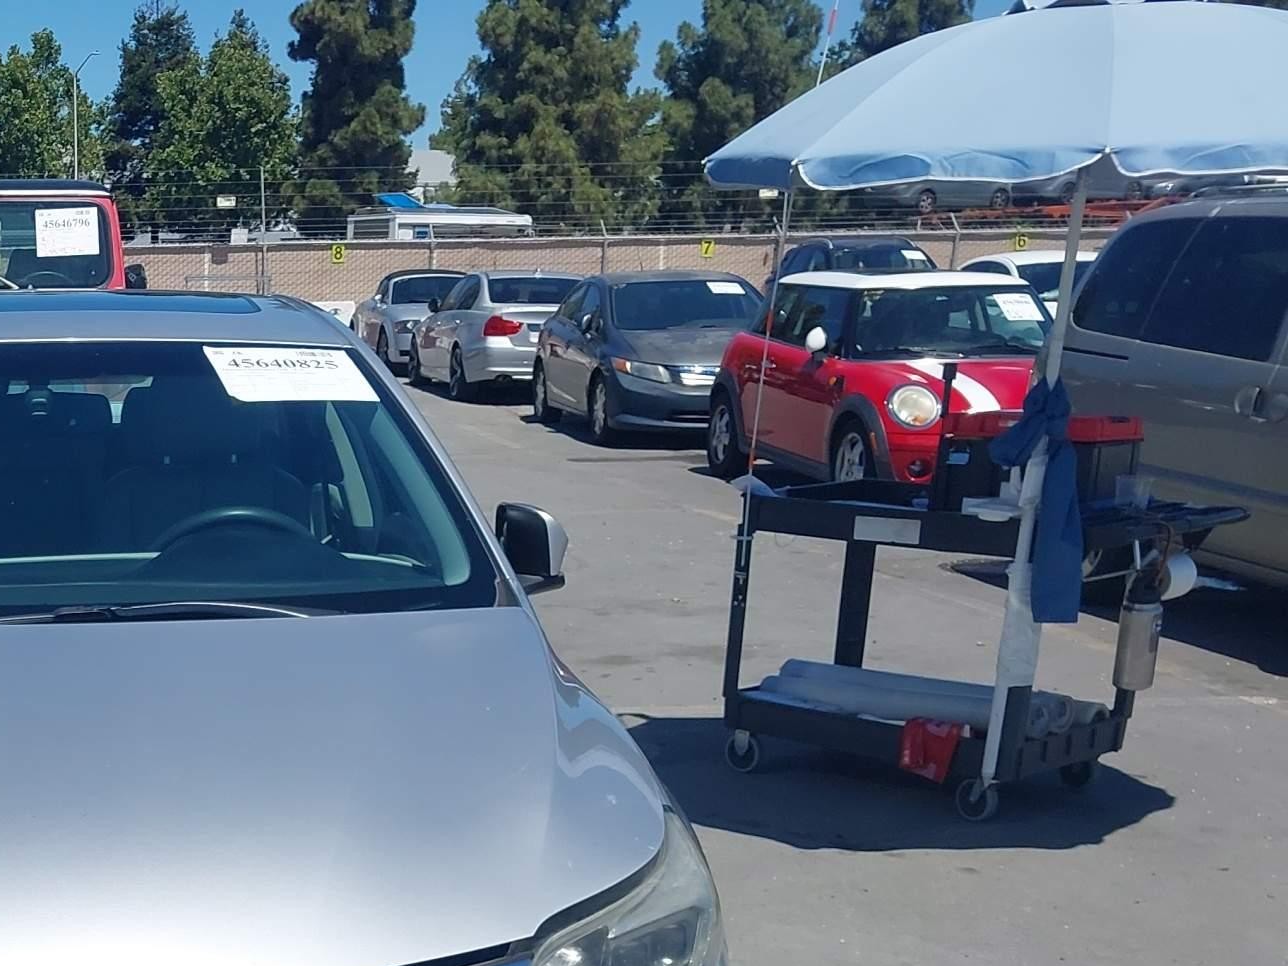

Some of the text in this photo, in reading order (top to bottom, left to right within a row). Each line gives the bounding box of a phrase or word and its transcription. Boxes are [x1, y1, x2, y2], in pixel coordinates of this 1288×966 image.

[43, 218, 90, 229] 45646796
[703, 240, 713, 255] 7
[1018, 234, 1026, 248] 6
[334, 245, 343, 260] 8
[226, 357, 340, 371] 45640825
